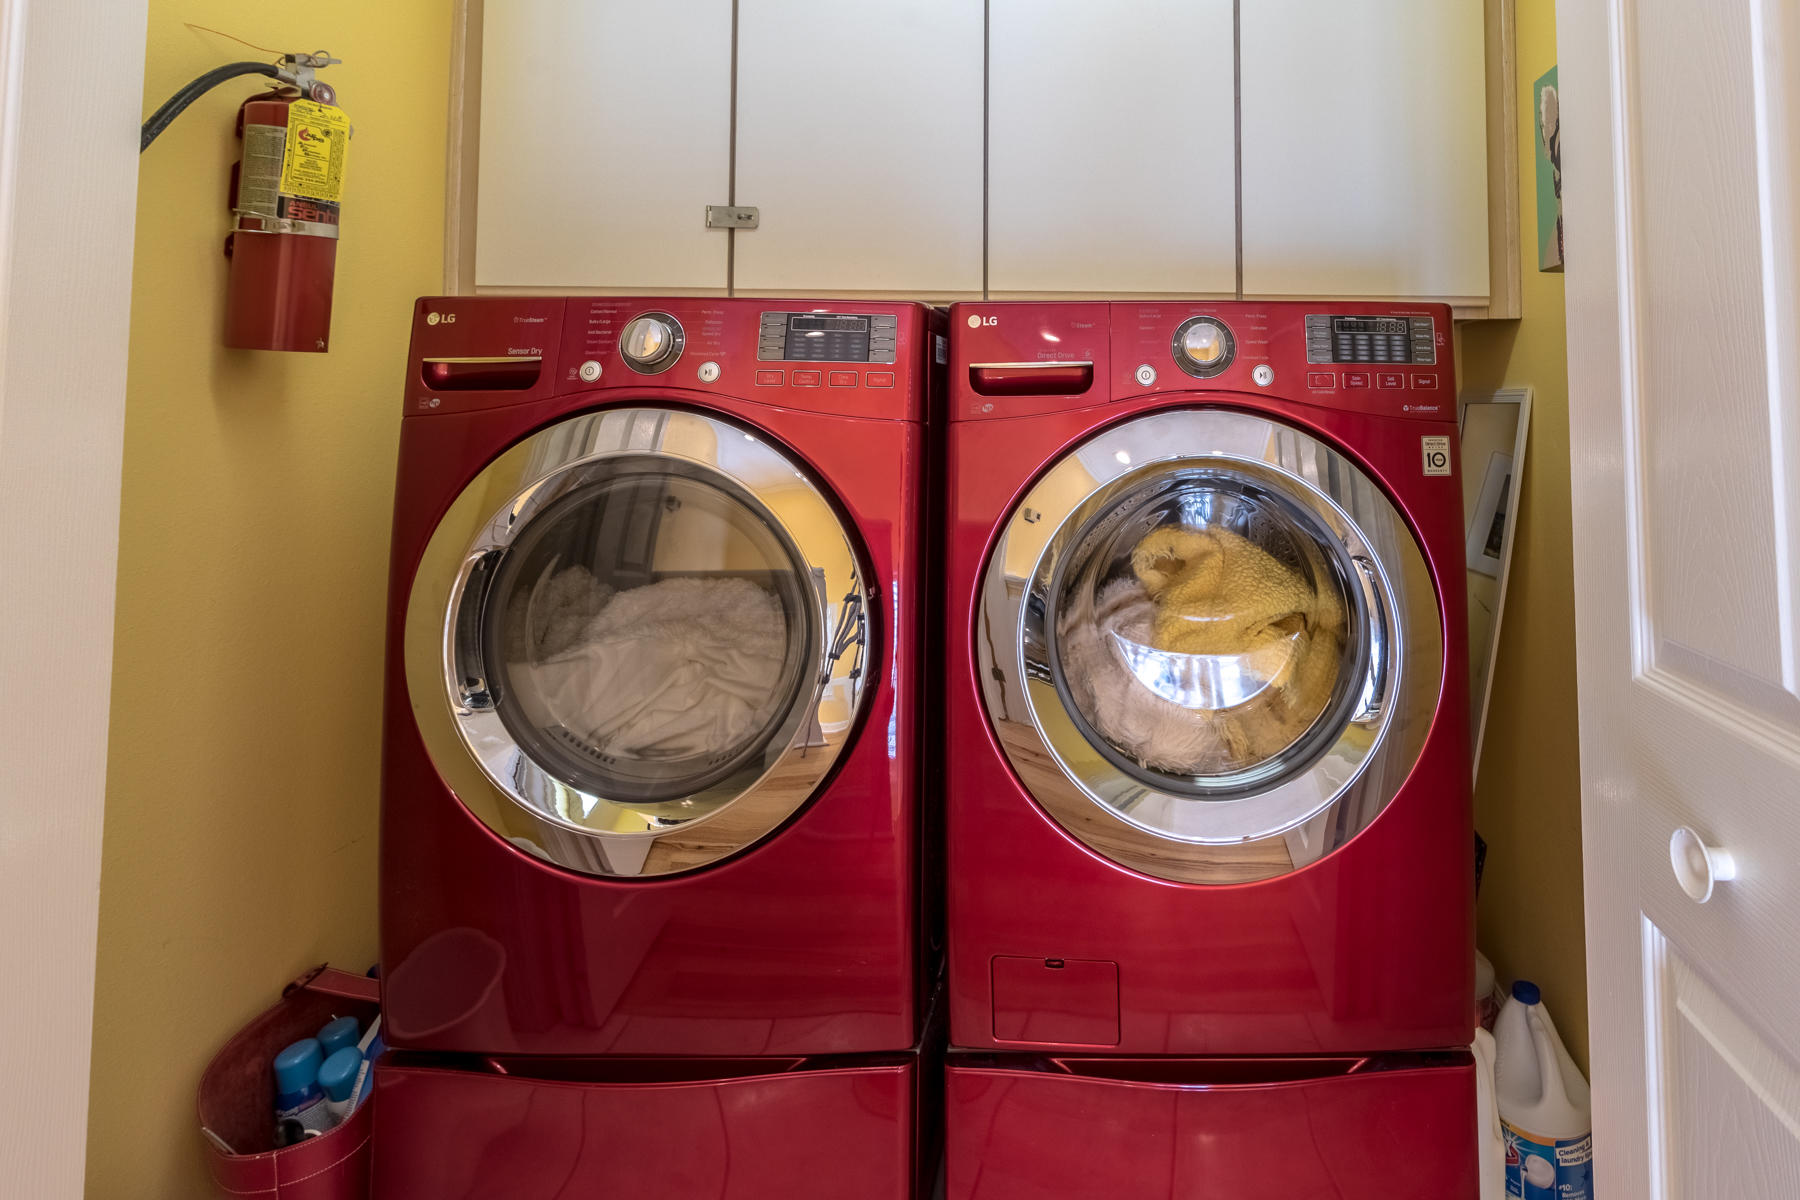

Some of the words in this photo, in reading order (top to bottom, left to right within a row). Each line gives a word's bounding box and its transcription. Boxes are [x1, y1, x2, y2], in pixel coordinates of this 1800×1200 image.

[441, 313, 456, 323] LG
[983, 316, 998, 326] LG
[508, 347, 530, 355] Sensor
[531, 346, 543, 356] Dry
[1037, 352, 1057, 360] Direct
[1427, 452, 1447, 468] 10
[1559, 1144, 1585, 1157] Cleaning
[1561, 1154, 1584, 1164] laundry
